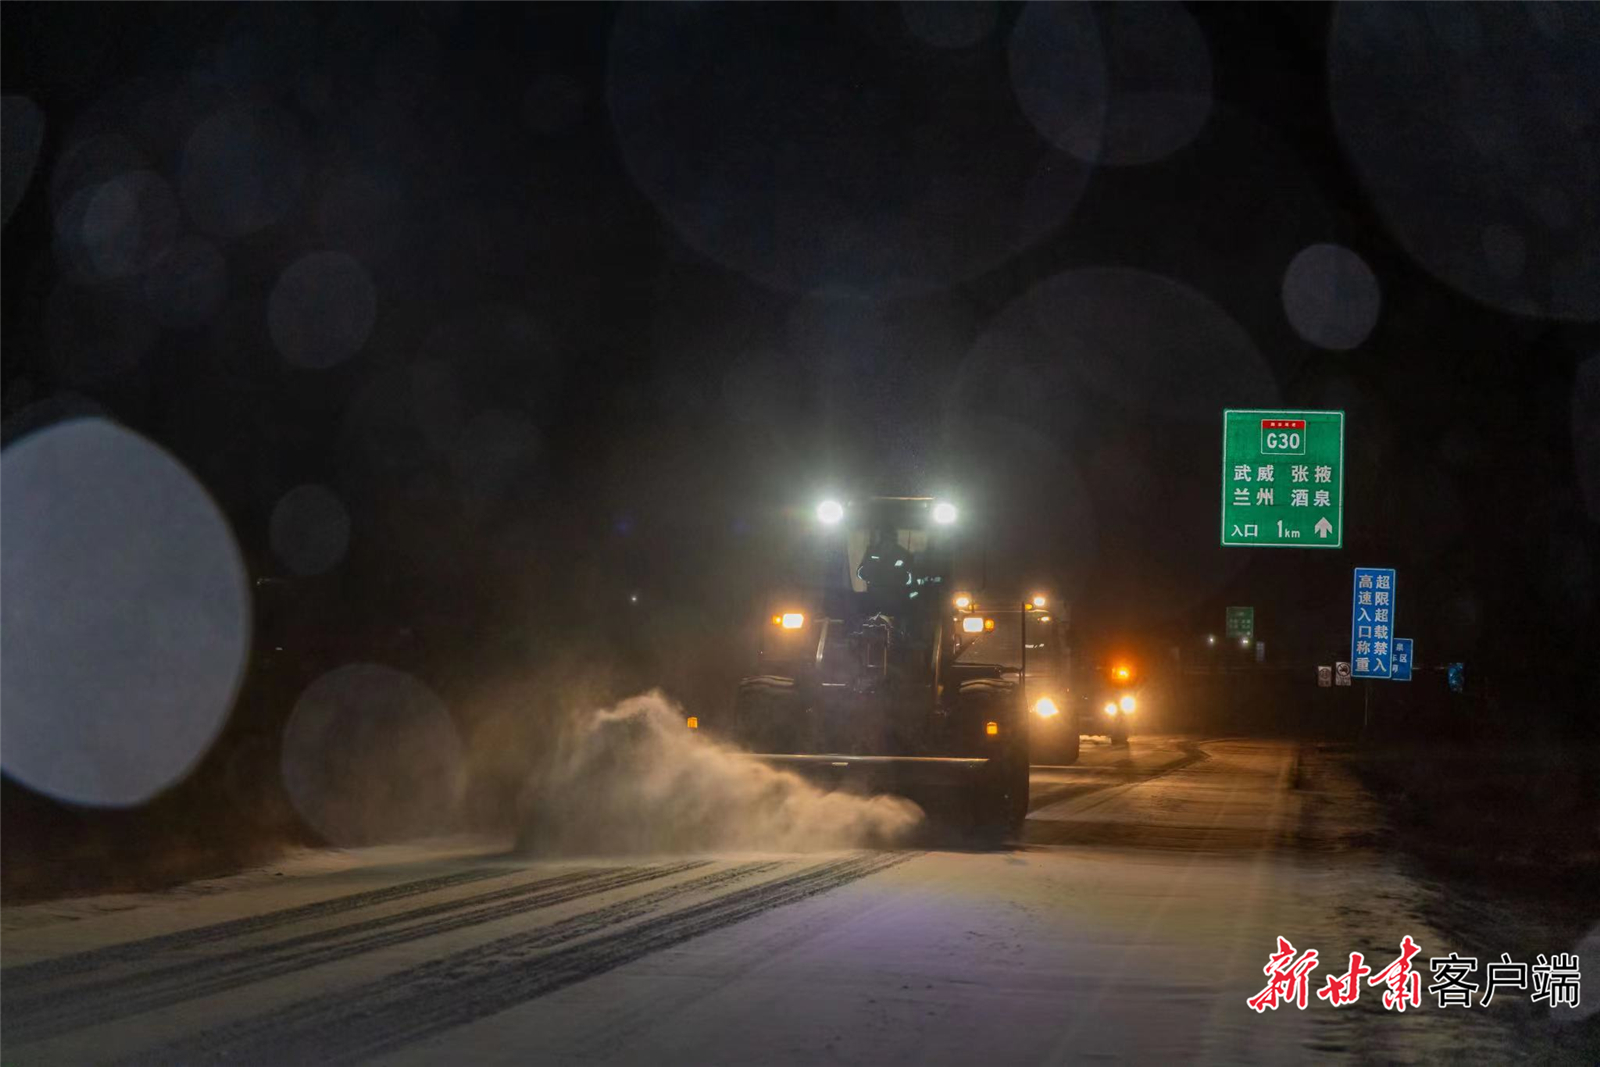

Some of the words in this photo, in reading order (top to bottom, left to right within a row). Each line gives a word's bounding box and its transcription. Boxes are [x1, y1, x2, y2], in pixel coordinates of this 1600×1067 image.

[1267, 433, 1300, 449] G30
[1233, 464, 1275, 482] 武威
[1291, 465, 1332, 483] 张掖
[1233, 488, 1274, 506] 兰州
[1291, 489, 1331, 507] 酒泉
[1231, 524, 1258, 538] 入口
[1277, 520, 1300, 538] 1km
[1355, 574, 1373, 673] 高速入口称重
[1373, 575, 1390, 673] 超限超载禁入
